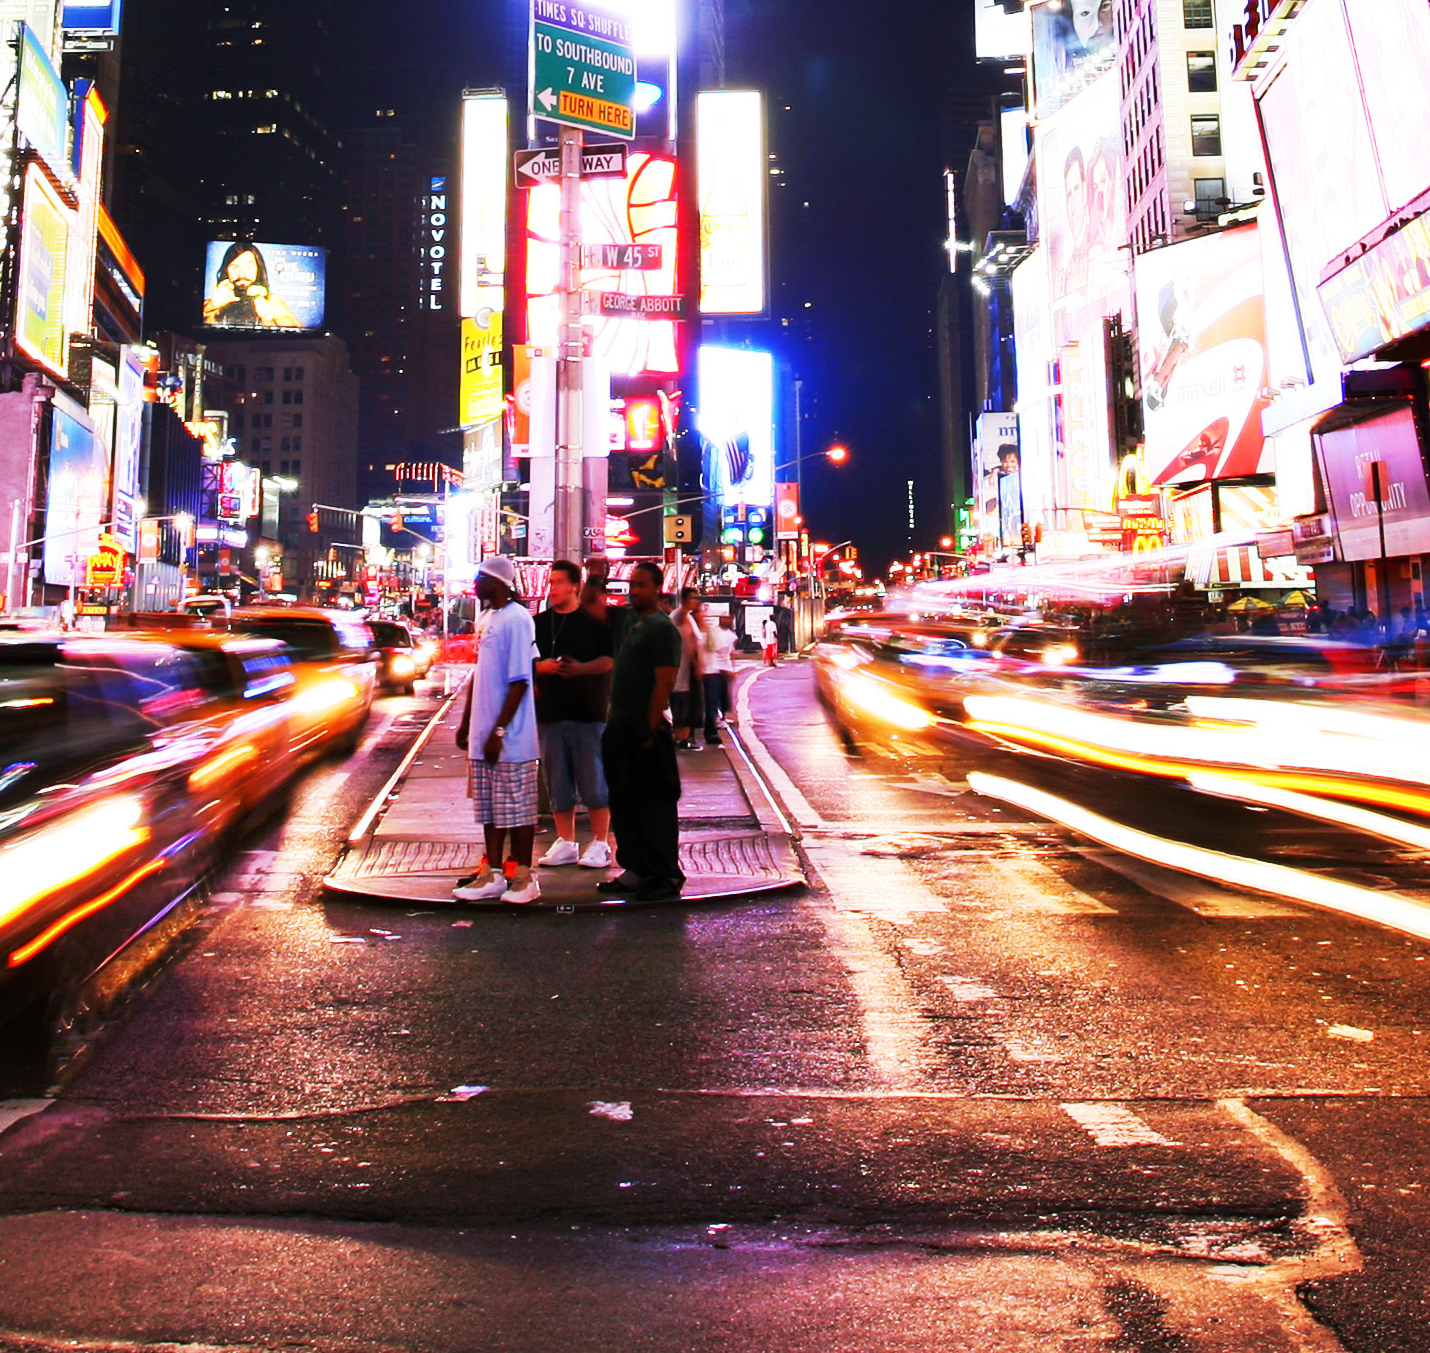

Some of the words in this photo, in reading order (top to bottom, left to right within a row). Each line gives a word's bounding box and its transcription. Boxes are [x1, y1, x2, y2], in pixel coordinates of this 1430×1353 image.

[588, 13, 632, 42] SHUFFLE
[536, 32, 552, 54] TO
[556, 38, 634, 75] SOUTHBOUND
[566, 66, 575, 84] 7
[581, 72, 605, 93] AVE
[561, 93, 594, 118] TURN
[598, 104, 629, 127] HERE
[531, 157, 559, 176] ONE
[581, 155, 614, 171] WAY
[429, 194, 447, 311] NOVOTEL
[606, 247, 618, 268] W
[623, 246, 643, 268] 45
[647, 246, 660, 258] ST
[602, 292, 637, 311] GEORGE
[640, 297, 682, 312] ABBOTT
